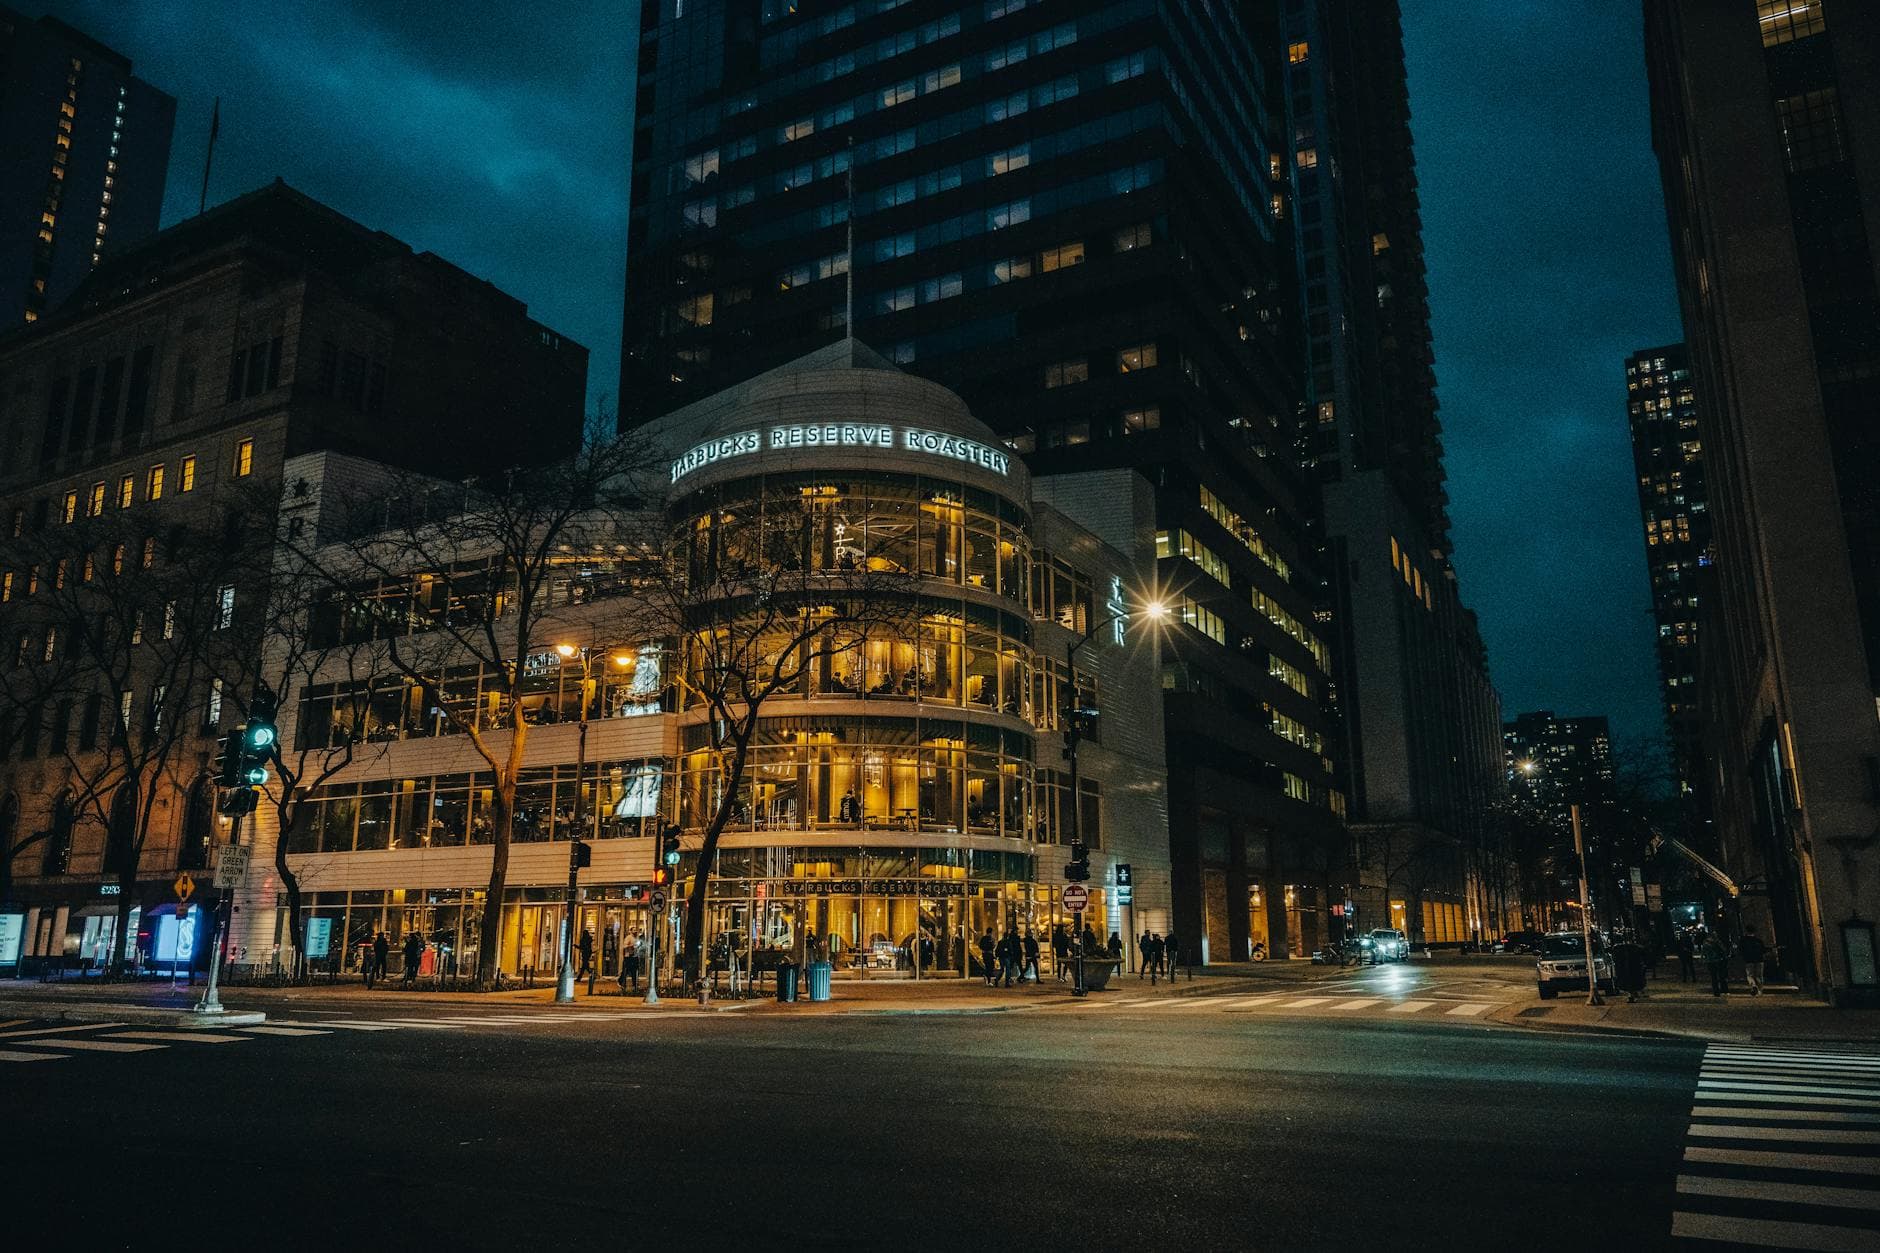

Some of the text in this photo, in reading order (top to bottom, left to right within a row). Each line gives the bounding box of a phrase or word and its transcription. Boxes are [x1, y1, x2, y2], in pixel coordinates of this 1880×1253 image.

[773, 426, 891, 445] RESERVE
[908, 432, 1009, 474] ROASTERY
[220, 846, 248, 857] LEFT ON
[222, 856, 243, 865] GREEN
[219, 866, 243, 875] ARROW
[222, 876, 239, 885] ONLY
[784, 882, 856, 893] STARBUCKS
